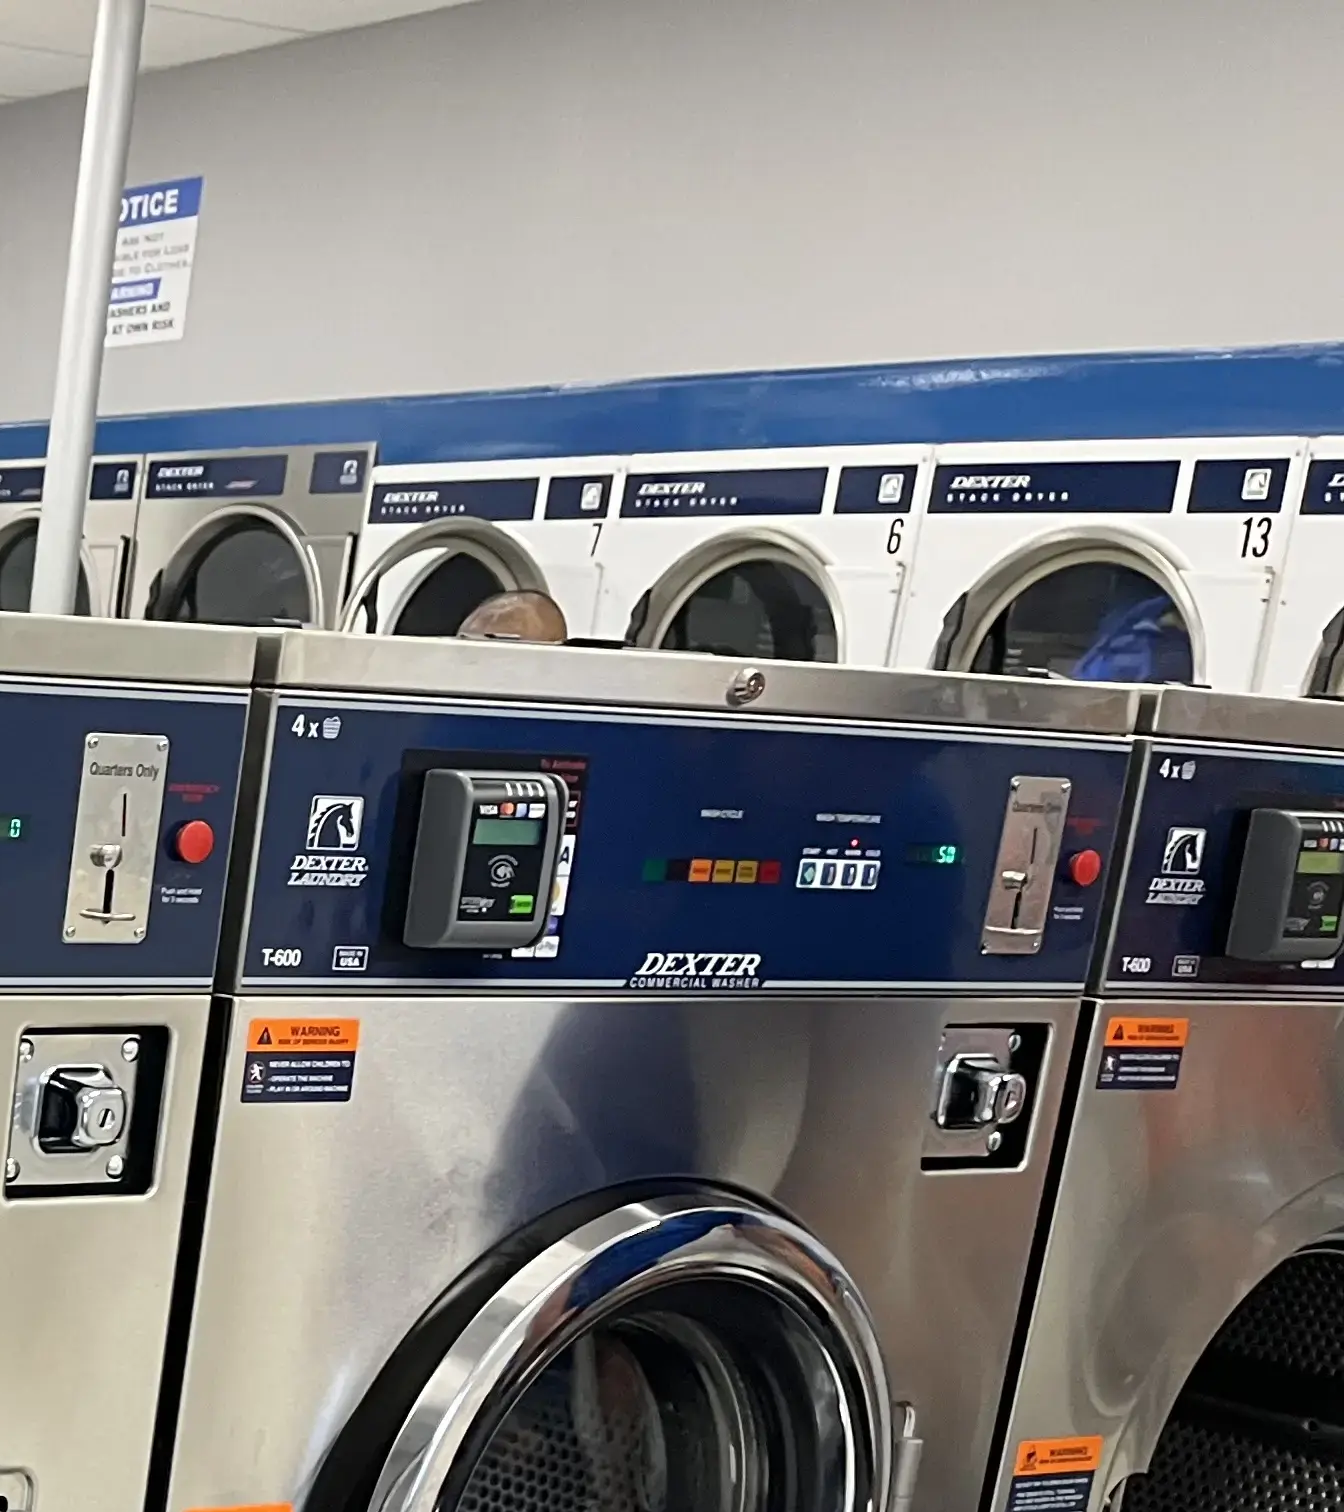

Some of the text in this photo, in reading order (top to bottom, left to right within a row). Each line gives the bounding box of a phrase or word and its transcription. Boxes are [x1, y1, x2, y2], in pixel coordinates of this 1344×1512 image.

[119, 188, 179, 222] OTICE
[108, 302, 170, 318] ASHERS AND
[112, 318, 174, 336] AT OWN RISK
[638, 482, 706, 496] DEXTER
[950, 475, 1031, 489] DEXTER
[383, 490, 439, 504] DEXTER
[590, 522, 603, 558] 7
[886, 518, 904, 554] 6
[1240, 516, 1272, 558] 13
[290, 714, 305, 737] 4
[90, 761, 160, 782] Quarters Only
[1158, 758, 1172, 779] 4
[290, 856, 364, 871] DEXTER
[287, 872, 367, 887] LAUNDRY
[1149, 878, 1204, 892] DEXTER
[262, 948, 302, 966] T-600
[634, 952, 762, 976] DEXTER
[629, 976, 760, 988] COMMERCIAL WASHER
[290, 1026, 340, 1037] WARNING
